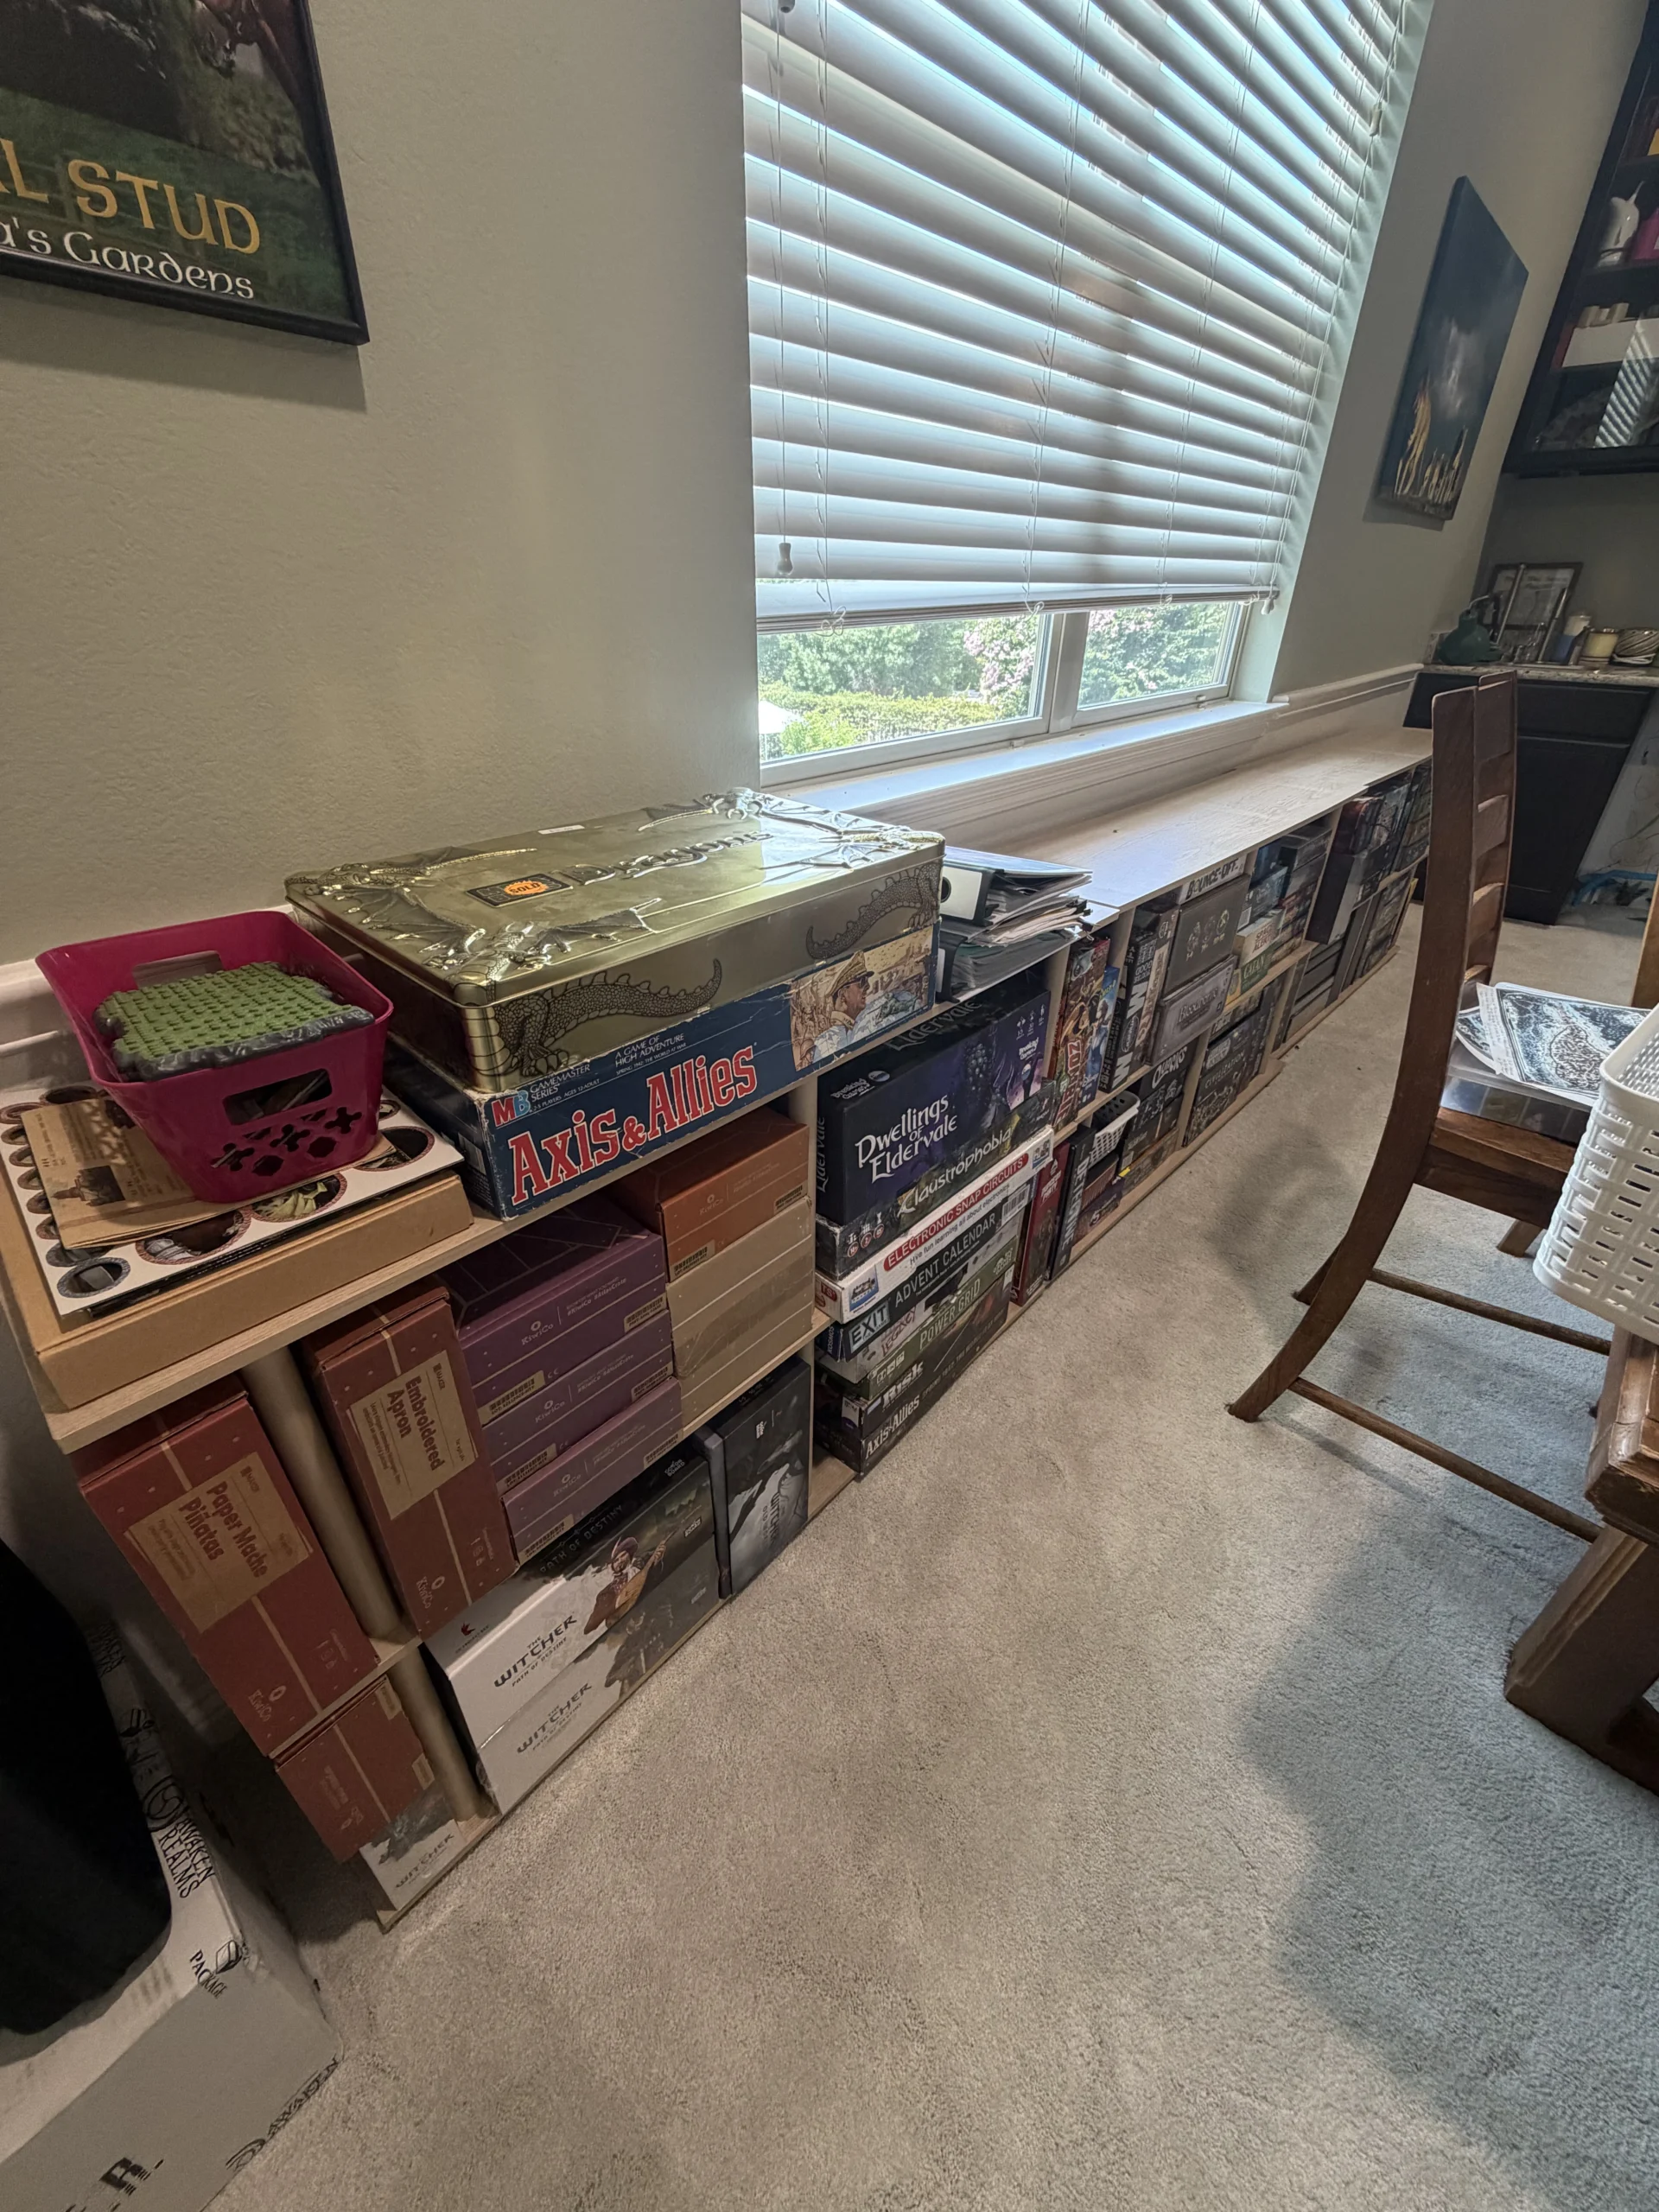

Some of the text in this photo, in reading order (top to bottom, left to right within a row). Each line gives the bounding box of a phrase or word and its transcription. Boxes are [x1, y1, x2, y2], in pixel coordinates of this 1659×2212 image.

[0, 138, 260, 254] L STUD
[64, 231, 254, 300] Gardens
[510, 882, 541, 894] SOLD
[615, 1033, 685, 1067] HIGH ADVENTURE
[623, 1041, 646, 1057] GAME
[648, 1035, 660, 1047] OF
[885, 1000, 982, 1052] Eldervale
[530, 1064, 591, 1094] GAMEMASTER
[616, 1066, 633, 1076] SPRING
[654, 1049, 671, 1061] WORLD
[491, 1090, 531, 1127] MB
[531, 1082, 561, 1103] SERIES
[542, 1096, 562, 1109] PLAYERS
[563, 1087, 577, 1098] AGES
[577, 1078, 601, 1093] 12-ADULT
[508, 1044, 759, 1206] Axis & Allies
[855, 1094, 950, 1169] Dwellings
[869, 1114, 958, 1185] Eldervale
[909, 1125, 925, 1142] OF
[897, 1128, 1012, 1218] Claustrophobia
[888, 1211, 954, 1268] ELECTRONIC
[956, 1190, 982, 1217] SNAP
[982, 1160, 1024, 1195] CIRCUITS
[923, 1243, 934, 1256] fun
[934, 1223, 958, 1245] learning
[966, 1205, 983, 1221] about
[895, 1258, 940, 1308] ADVENT
[942, 1212, 995, 1266] CALENDAR
[521, 1323, 555, 1345] KiwiCo
[851, 1304, 888, 1348] EXIT
[881, 1306, 917, 1357] LEGACY
[919, 1306, 957, 1351] POWER
[957, 1279, 981, 1313] GRID
[387, 1389, 413, 1439] Apron
[405, 1375, 446, 1471] Embroidered
[535, 1401, 566, 1424] KiwiCo
[865, 1427, 889, 1459] Axis
[892, 1394, 920, 1433] Allies
[178, 1496, 226, 1561] Piñatas
[206, 1480, 269, 1579] Paper Mache
[569, 1538, 582, 1552] OF
[583, 1504, 623, 1541] DESTINY
[493, 1614, 578, 1688] WITCHER
[512, 1669, 530, 1688] PATH
[540, 1636, 568, 1662] DESTINY
[526, 1635, 542, 1649] THE
[517, 1682, 593, 1753] WITCHER
[158, 1829, 200, 1899] REALMS
[175, 1815, 216, 1884] AWAKEN
[395, 1833, 454, 1889] WITCHER
[189, 1948, 228, 1999] PACKAGE
